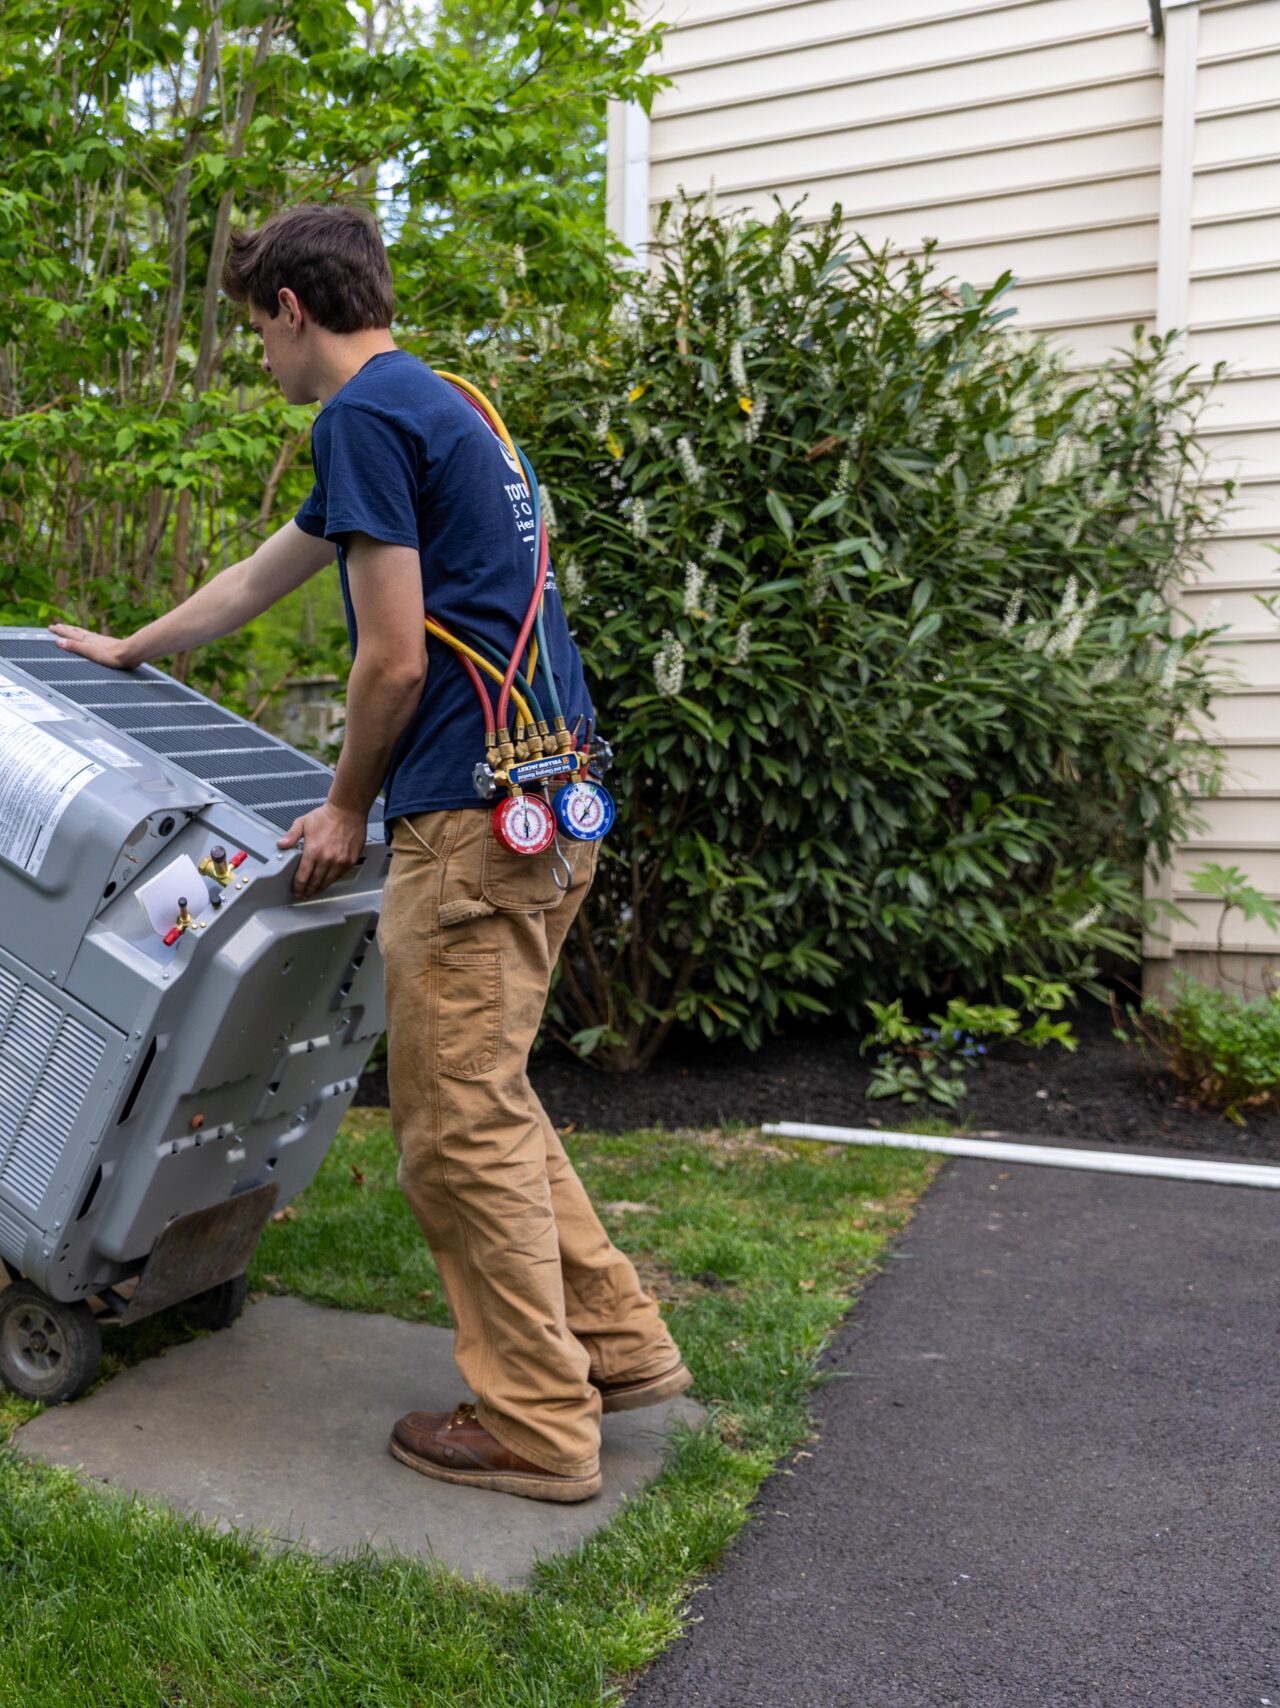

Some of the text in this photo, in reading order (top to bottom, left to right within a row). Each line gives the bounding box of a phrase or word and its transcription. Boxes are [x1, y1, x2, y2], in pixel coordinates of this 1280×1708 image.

[516, 519, 534, 532] Hea
[517, 759, 562, 773] YELLOW JACKET
